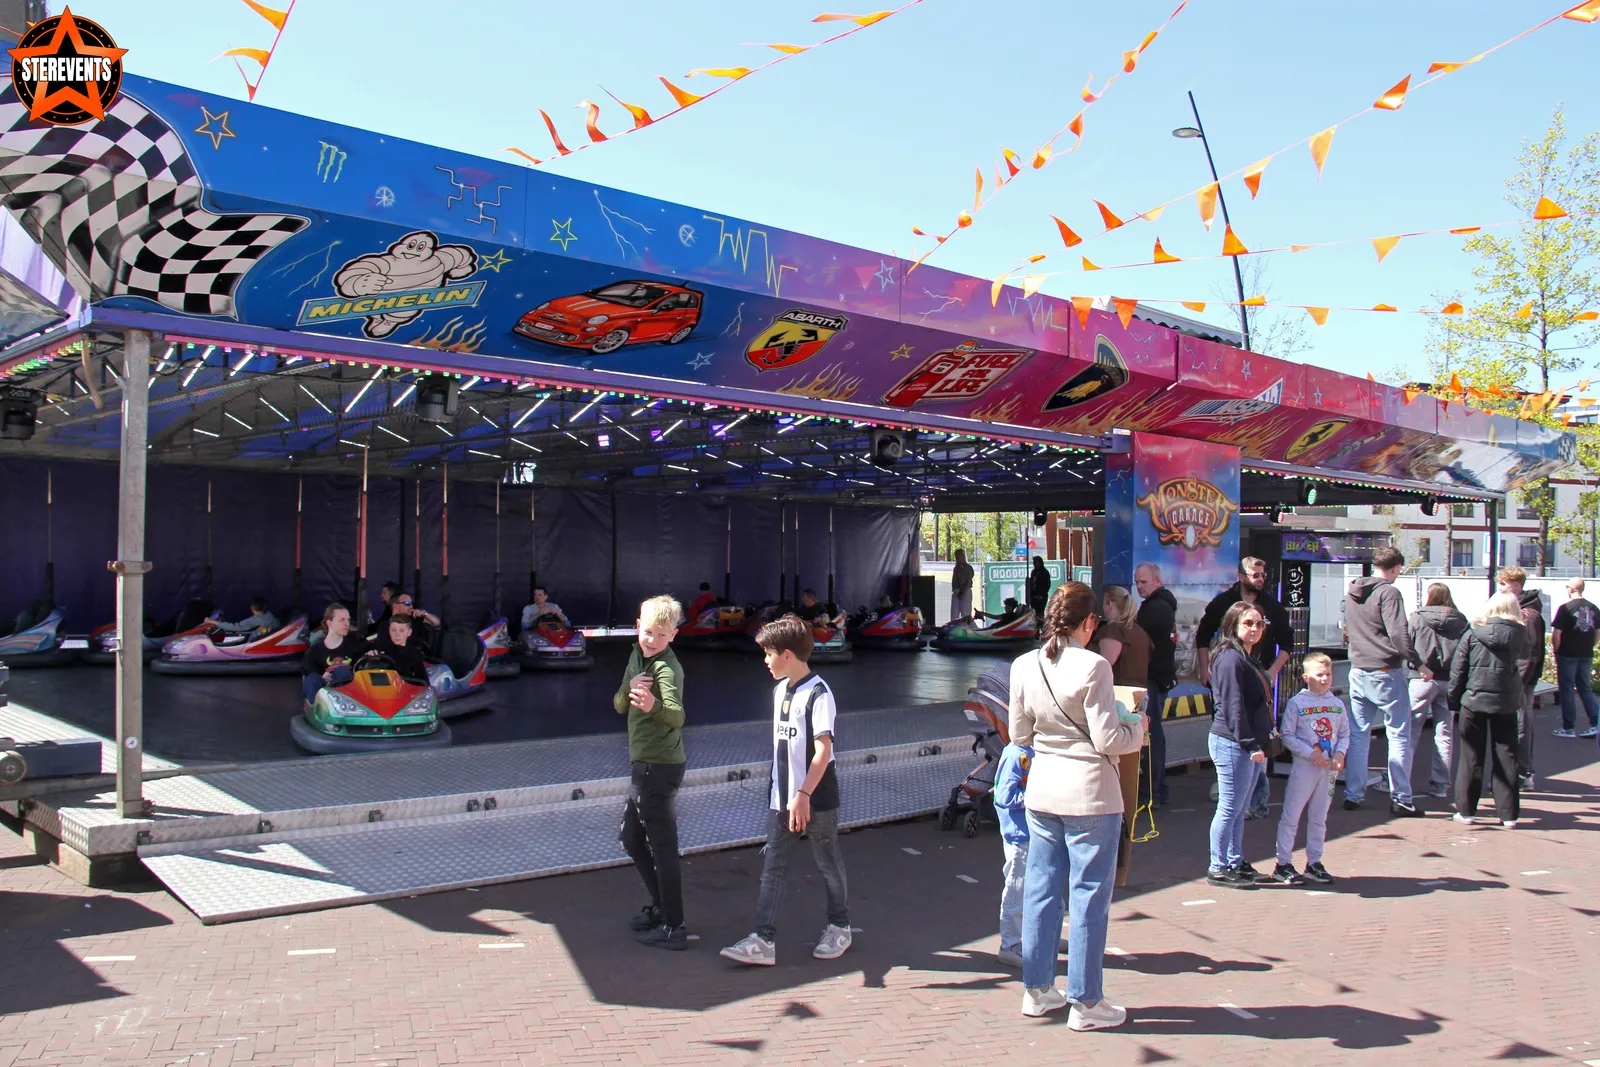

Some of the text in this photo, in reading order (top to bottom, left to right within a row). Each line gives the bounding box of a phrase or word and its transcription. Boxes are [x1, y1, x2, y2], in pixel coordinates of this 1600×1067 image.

[308, 287, 472, 319] MICHELIN
[782, 312, 842, 328] ABARTH
[958, 354, 1019, 369] FUEL
[960, 368, 991, 378] FOR
[931, 378, 990, 393] LIFE
[1137, 475, 1238, 533] MONSTER
[1171, 506, 1211, 526] GARAGE
